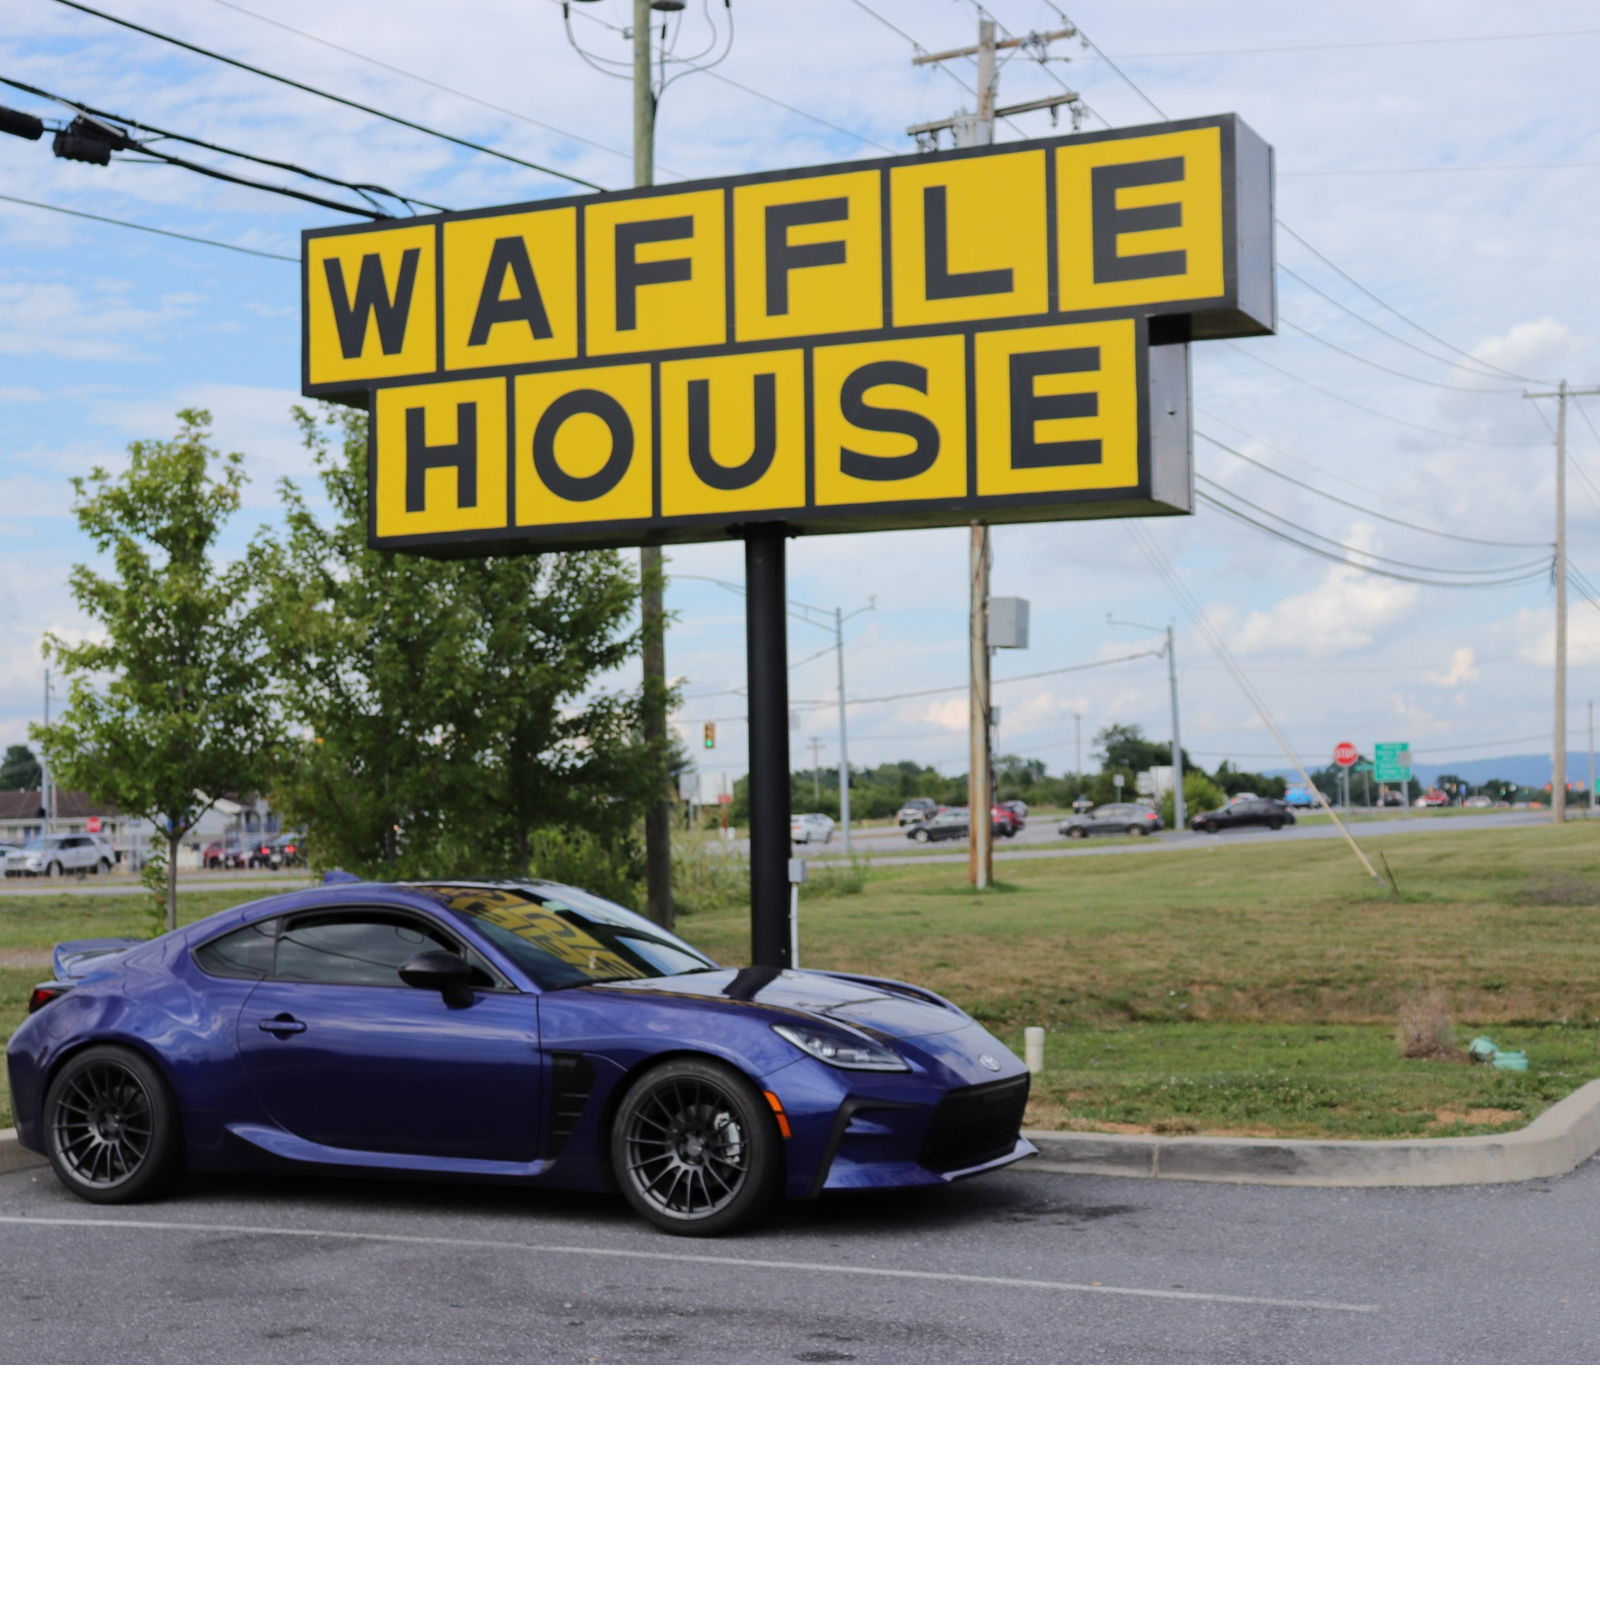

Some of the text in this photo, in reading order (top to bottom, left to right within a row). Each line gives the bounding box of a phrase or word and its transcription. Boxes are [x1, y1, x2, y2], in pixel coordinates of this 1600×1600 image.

[323, 156, 1187, 359] WAFFLE
[406, 346, 1102, 513] HOUSE
[1335, 748, 1356, 759] STOP
